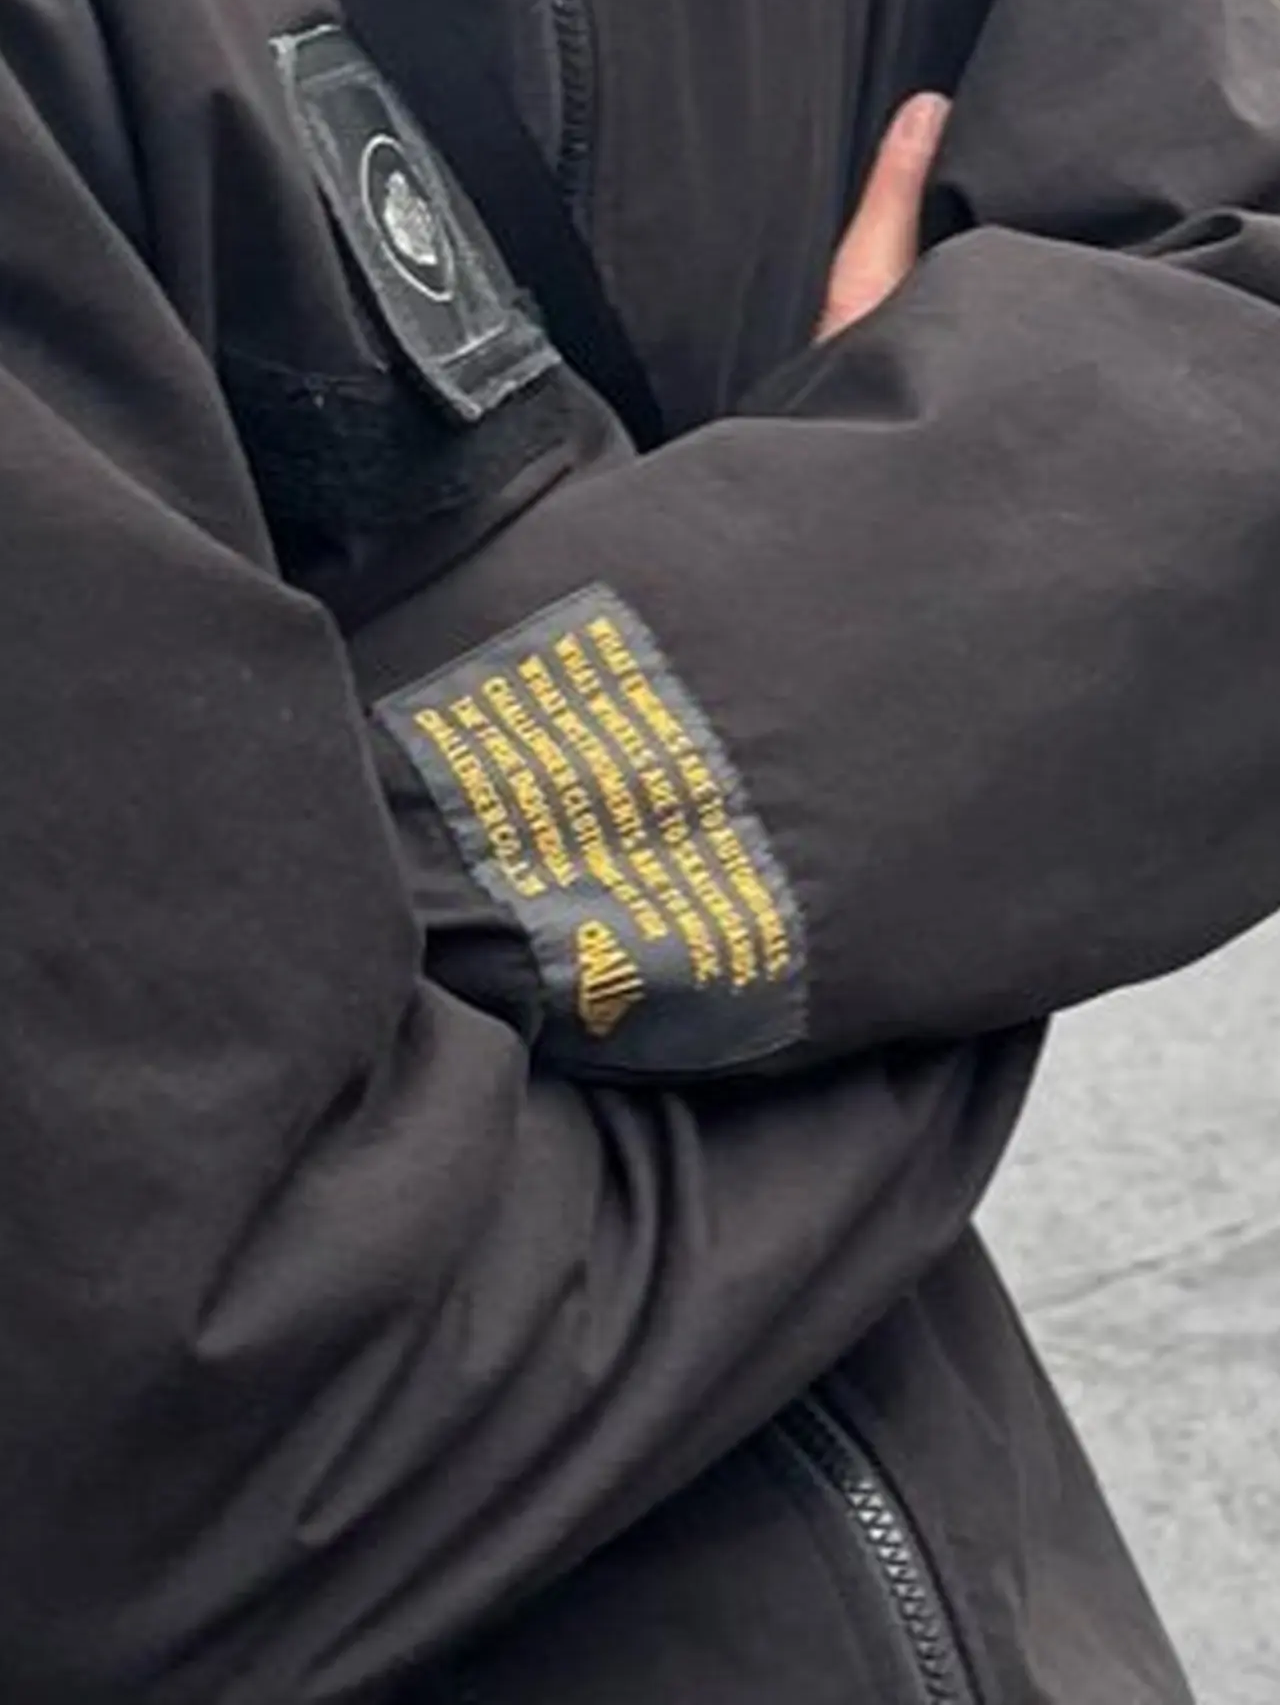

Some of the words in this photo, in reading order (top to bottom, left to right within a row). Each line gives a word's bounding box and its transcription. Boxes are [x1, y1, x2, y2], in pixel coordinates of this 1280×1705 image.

[518, 657, 570, 717] WHAT
[554, 637, 600, 695] WHAT
[636, 761, 681, 814] ARE
[659, 808, 689, 849] TO
[584, 620, 637, 677] WHAT
[674, 749, 717, 804] ARE
